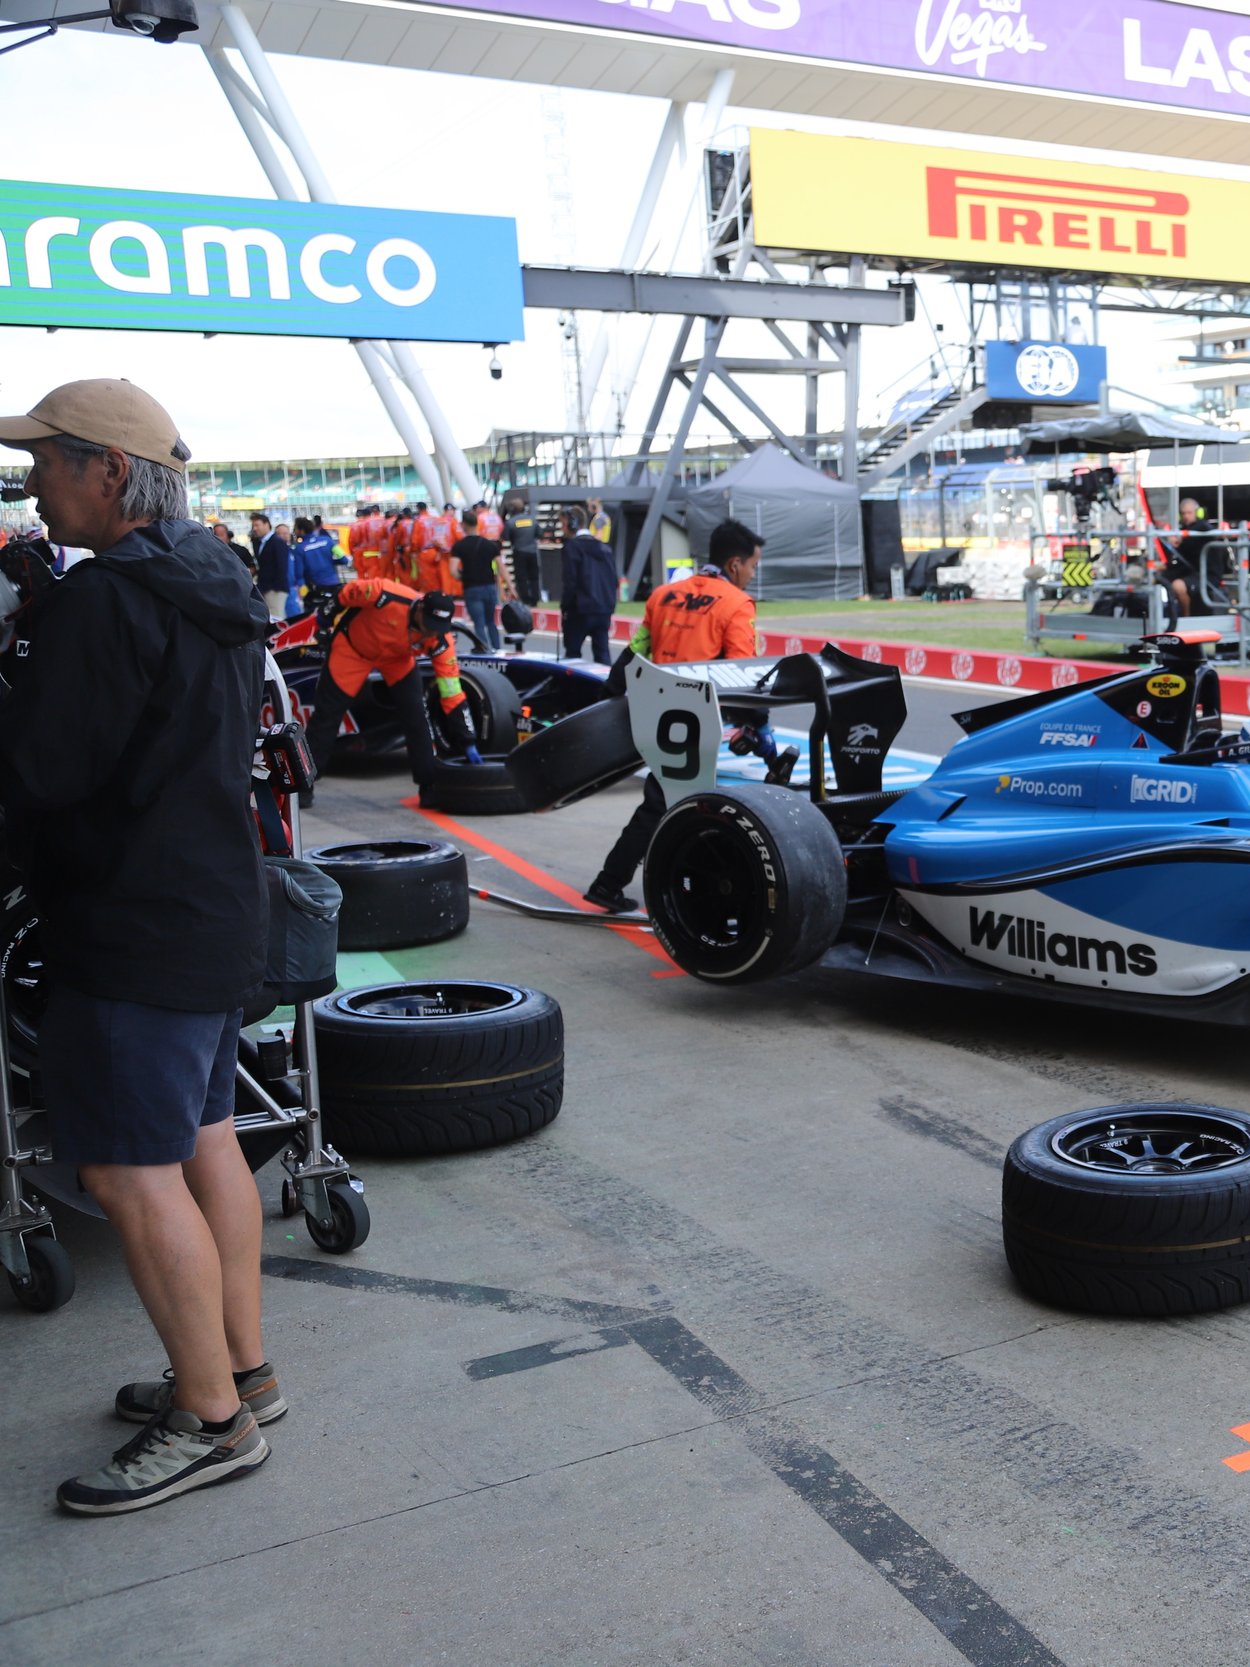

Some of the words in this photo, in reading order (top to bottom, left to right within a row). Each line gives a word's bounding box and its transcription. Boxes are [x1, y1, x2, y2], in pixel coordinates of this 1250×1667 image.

[914, 0, 1047, 77] Vegas
[926, 166, 1190, 259] PIRELLI
[1151, 681, 1181, 690] KROON
[1158, 688, 1171, 696] OIL
[656, 709, 701, 781] 9
[1040, 732, 1090, 747] FFSA
[1010, 777, 1083, 798] Prop.com
[1143, 778, 1193, 804] GRID
[720, 804, 737, 816] P
[736, 818, 777, 882] ZERO
[968, 905, 1158, 977] Williams
